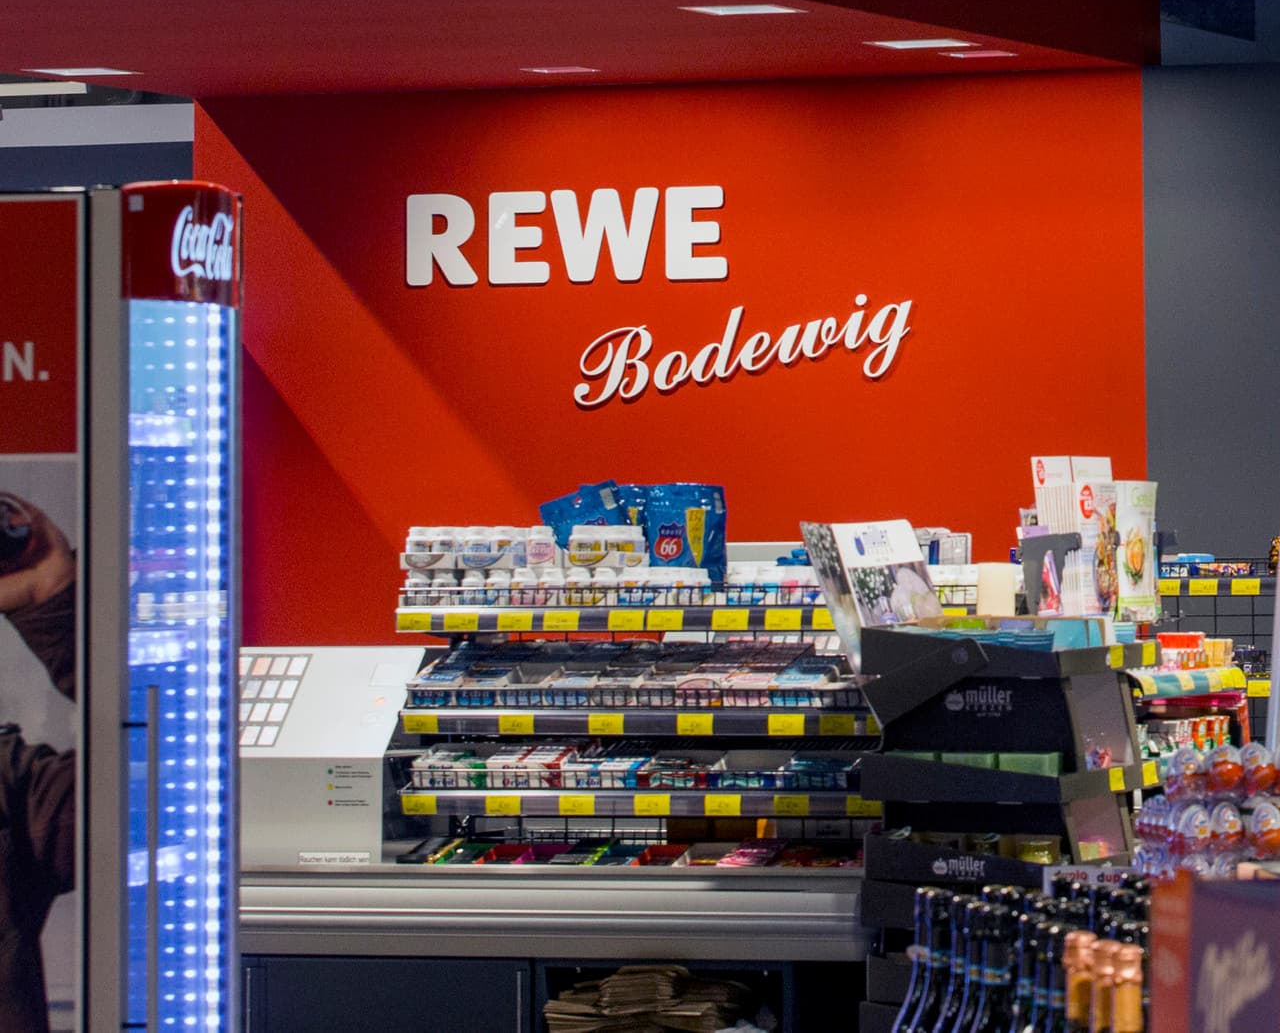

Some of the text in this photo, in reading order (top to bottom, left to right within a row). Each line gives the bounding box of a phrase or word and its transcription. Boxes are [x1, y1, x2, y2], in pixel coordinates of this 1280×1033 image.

[406, 186, 728, 287] REWE
[573, 294, 913, 407] Bodewig
[659, 539, 678, 556] 66
[966, 685, 1013, 703] müller
[949, 856, 986, 873] müller
